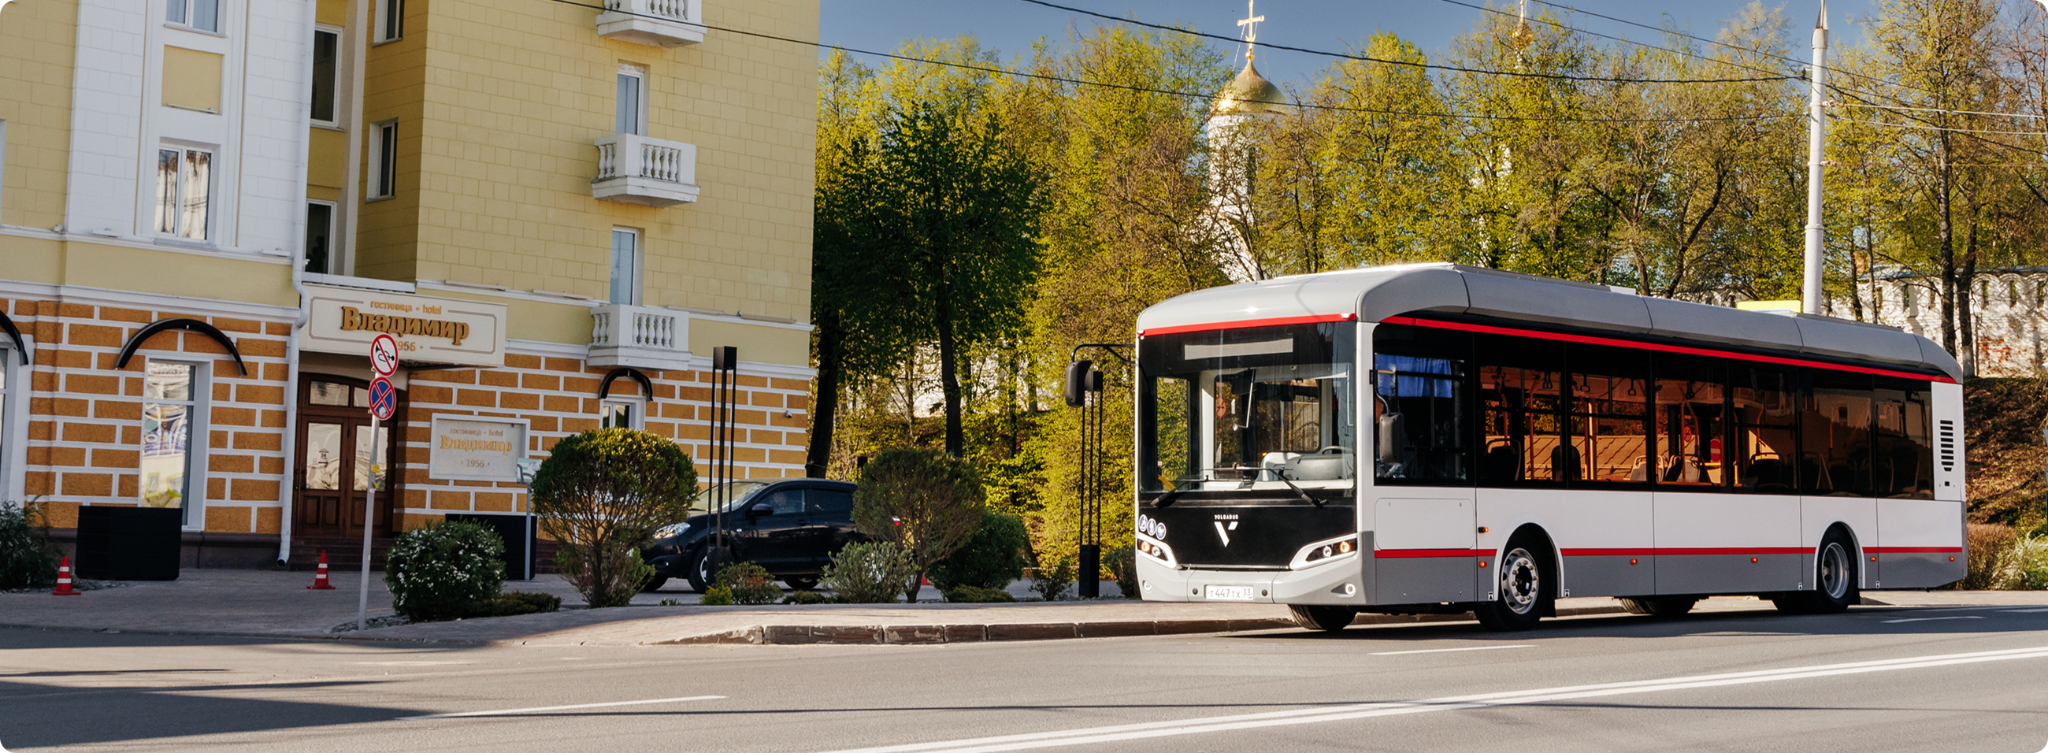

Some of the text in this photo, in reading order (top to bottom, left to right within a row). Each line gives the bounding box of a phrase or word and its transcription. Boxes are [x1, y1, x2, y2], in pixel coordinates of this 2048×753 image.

[371, 301, 442, 315] гостиница hotel
[340, 306, 470, 346] Владимир
[395, 340, 416, 352] 956
[489, 429, 504, 437] hotel
[440, 435, 512, 456] Владимир
[466, 459, 485, 468] 1956
